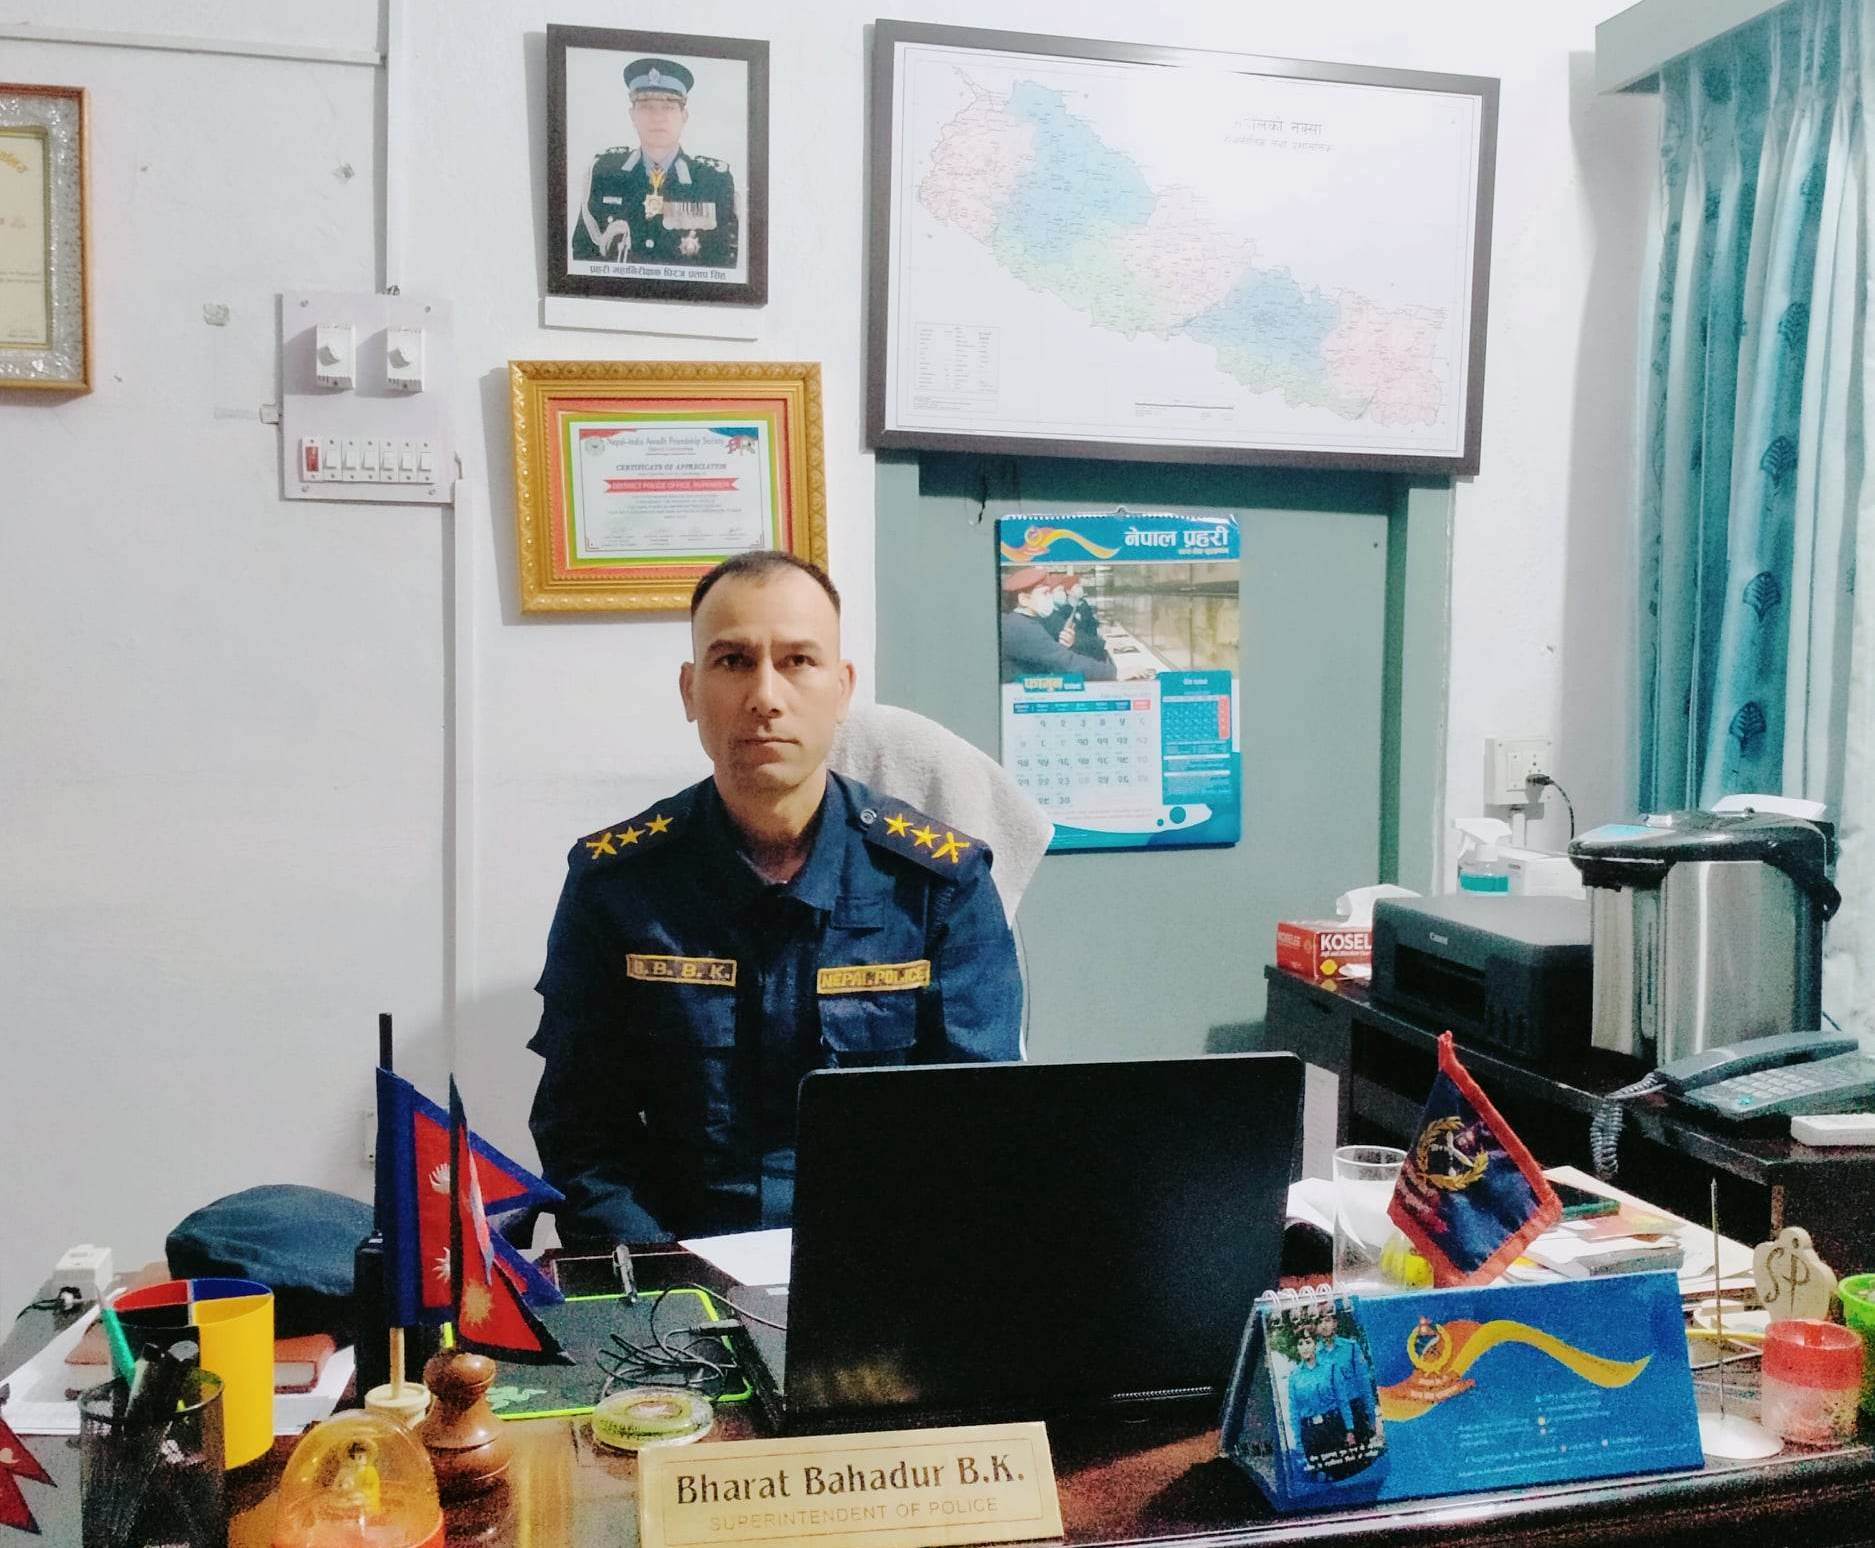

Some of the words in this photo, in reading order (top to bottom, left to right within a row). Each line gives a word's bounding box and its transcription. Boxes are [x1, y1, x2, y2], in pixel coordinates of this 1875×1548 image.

[1122, 525, 1177, 547] नेपाल
[1183, 525, 1229, 548] प्रहरी
[677, 1469, 789, 1505] Bharat
[805, 1461, 945, 1496] Bahadur
[957, 1454, 1025, 1485] B.K.
[710, 1505, 887, 1532] SUPERINTENDENT
[896, 1503, 920, 1519] OF
[929, 1497, 999, 1516] POLICE
